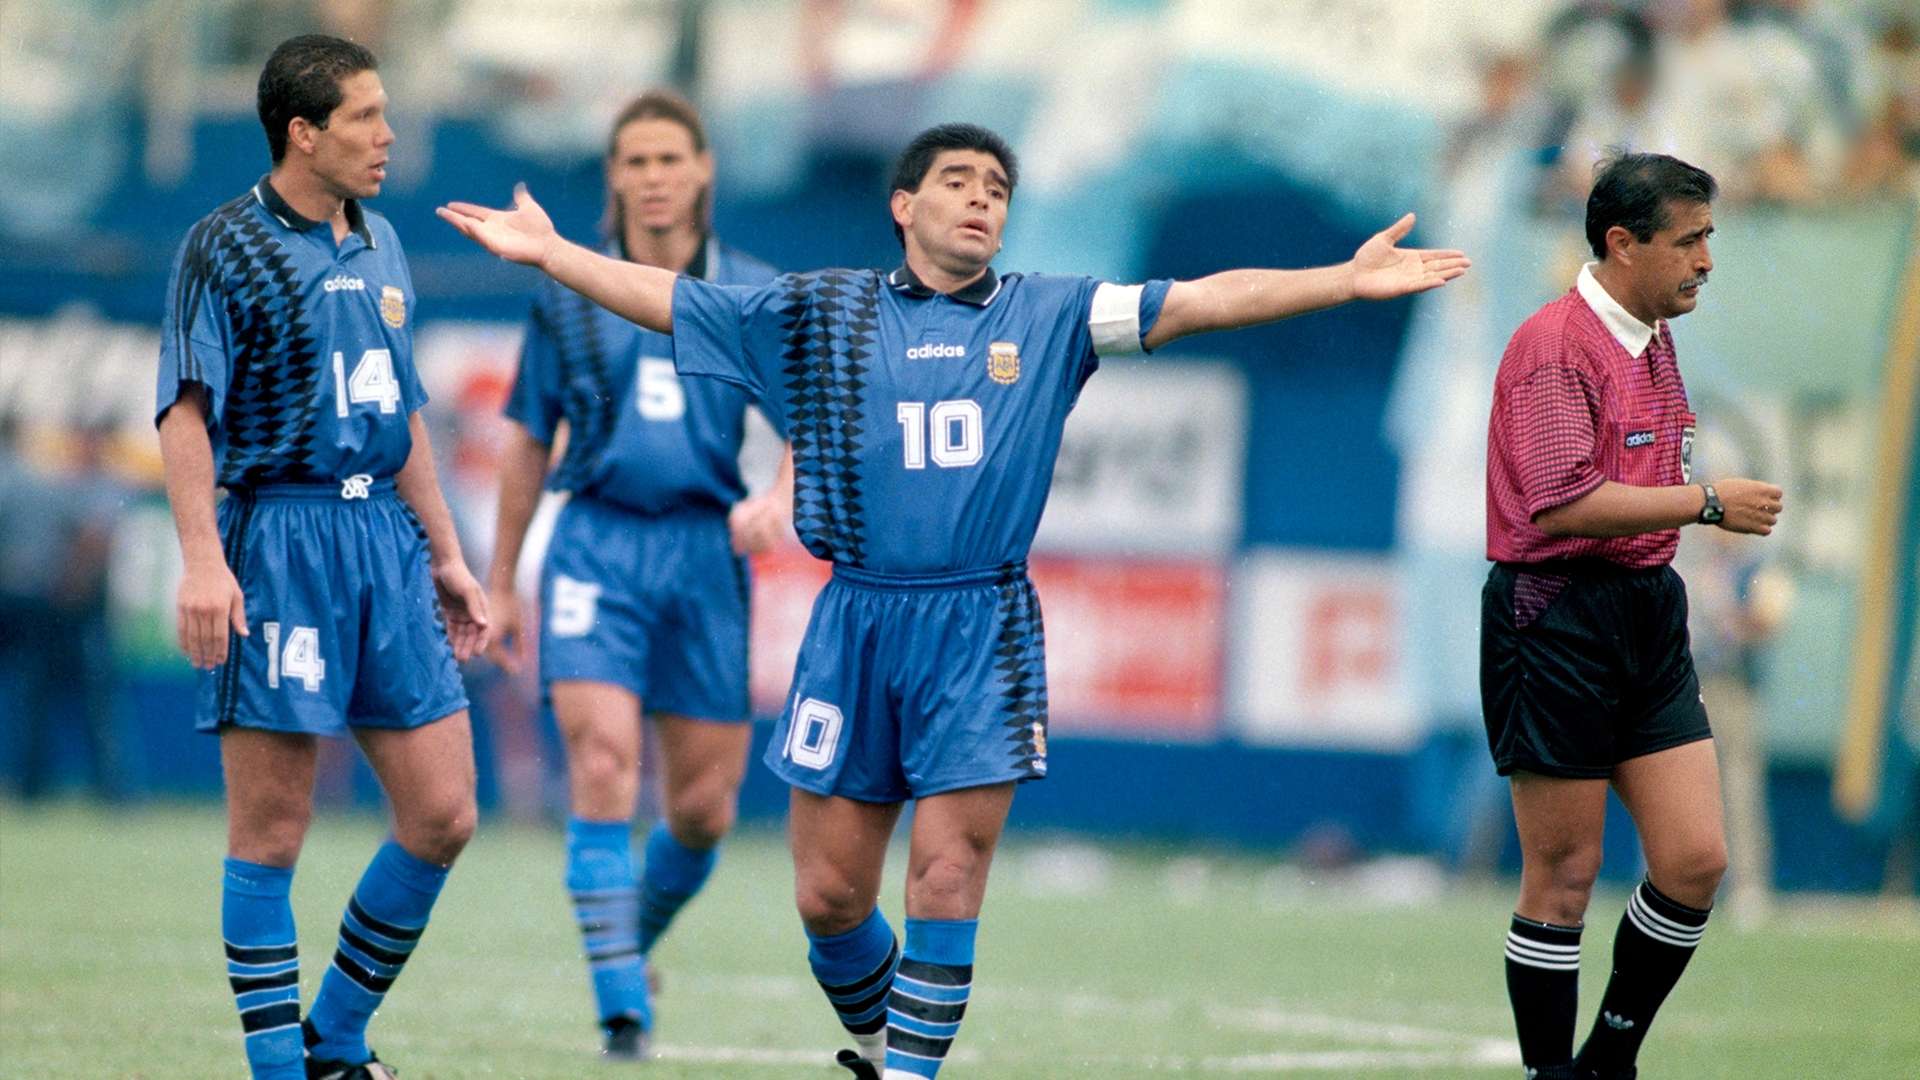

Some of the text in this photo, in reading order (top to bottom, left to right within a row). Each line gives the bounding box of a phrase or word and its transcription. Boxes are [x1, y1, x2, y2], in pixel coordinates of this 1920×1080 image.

[324, 275, 365, 292] addas
[333, 349, 400, 418] 14
[906, 343, 965, 359] adidas
[636, 356, 686, 421] 5
[897, 399, 984, 469] 10
[551, 575, 602, 636] 5
[263, 622, 325, 692] 14
[782, 692, 844, 770] 0
